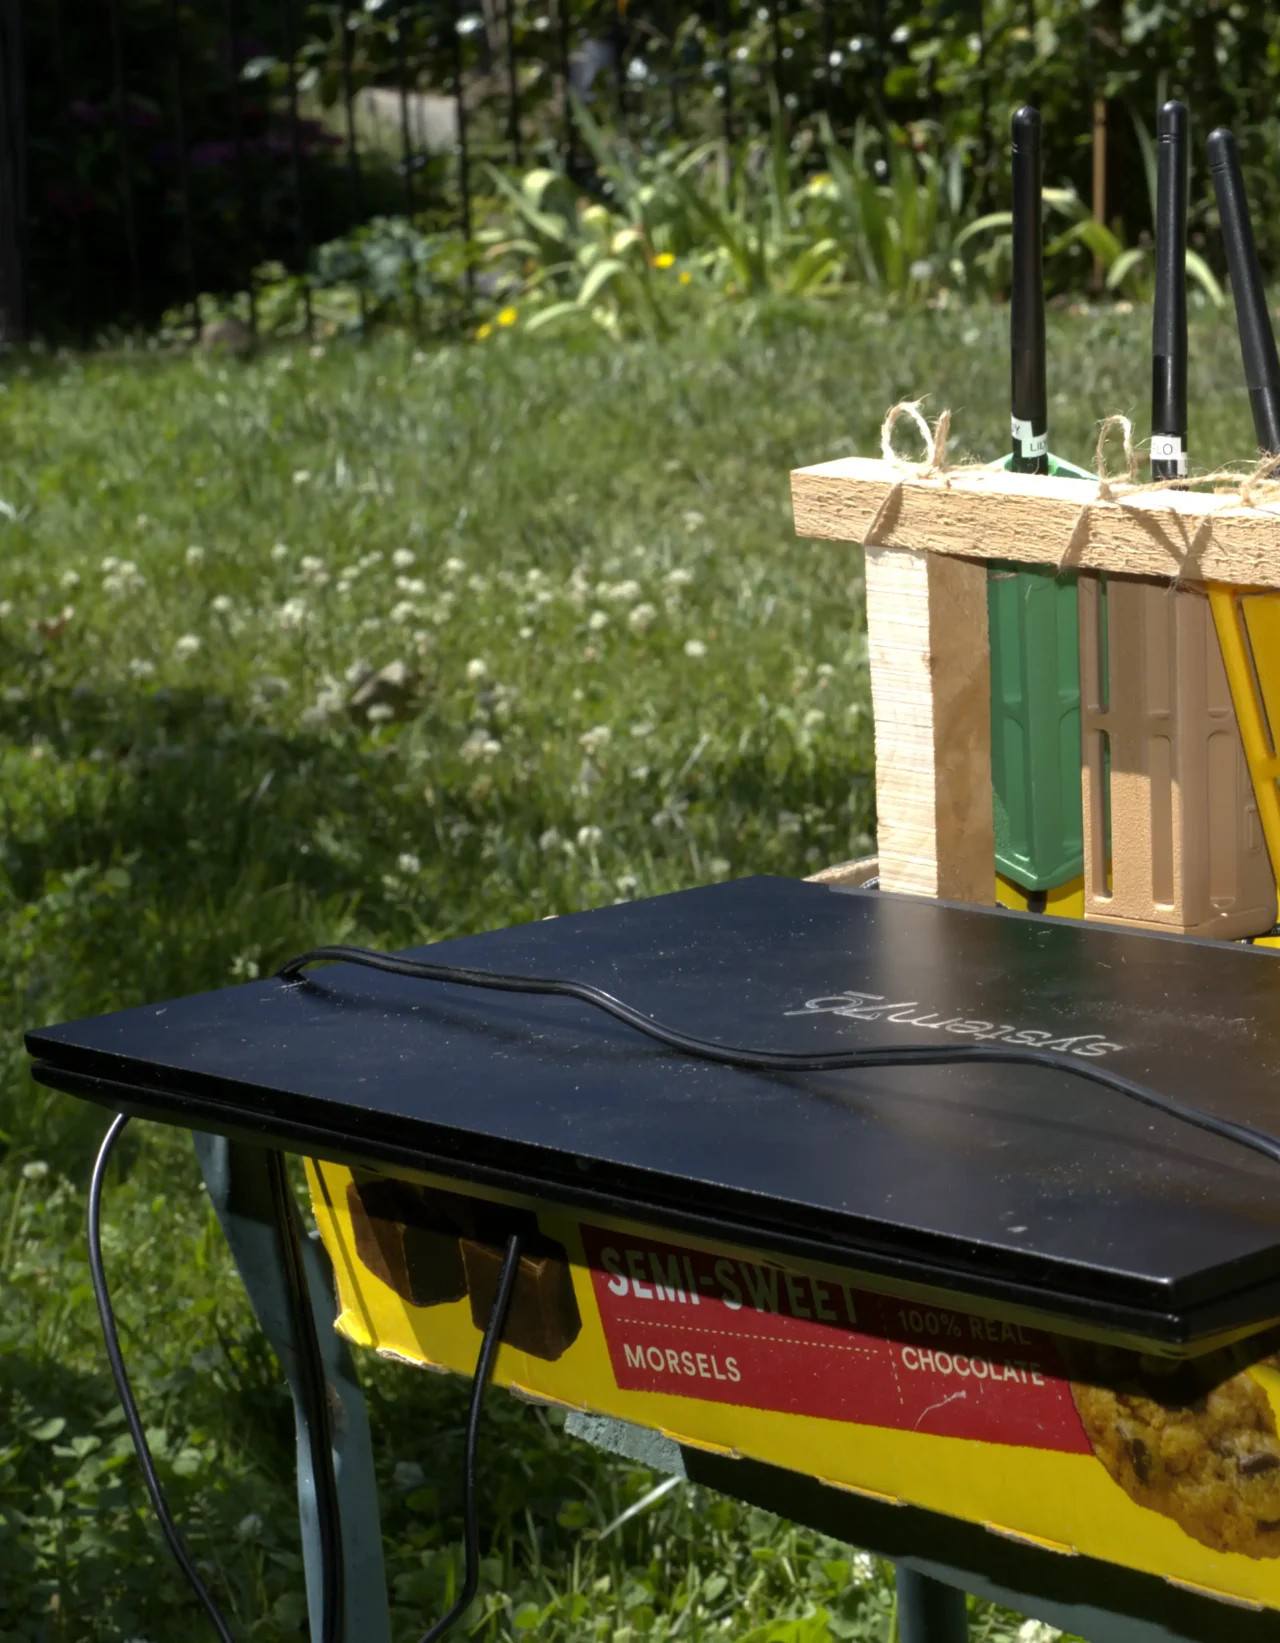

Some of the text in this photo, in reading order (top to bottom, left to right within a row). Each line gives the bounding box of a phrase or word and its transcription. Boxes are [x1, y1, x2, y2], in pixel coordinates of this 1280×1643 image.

[600, 1246, 859, 1324] SEMI-SWEET
[897, 1309, 1033, 1346] 100% REAL
[623, 1342, 742, 1384] MORSELS
[901, 1346, 1046, 1387] CHOCOLATE
